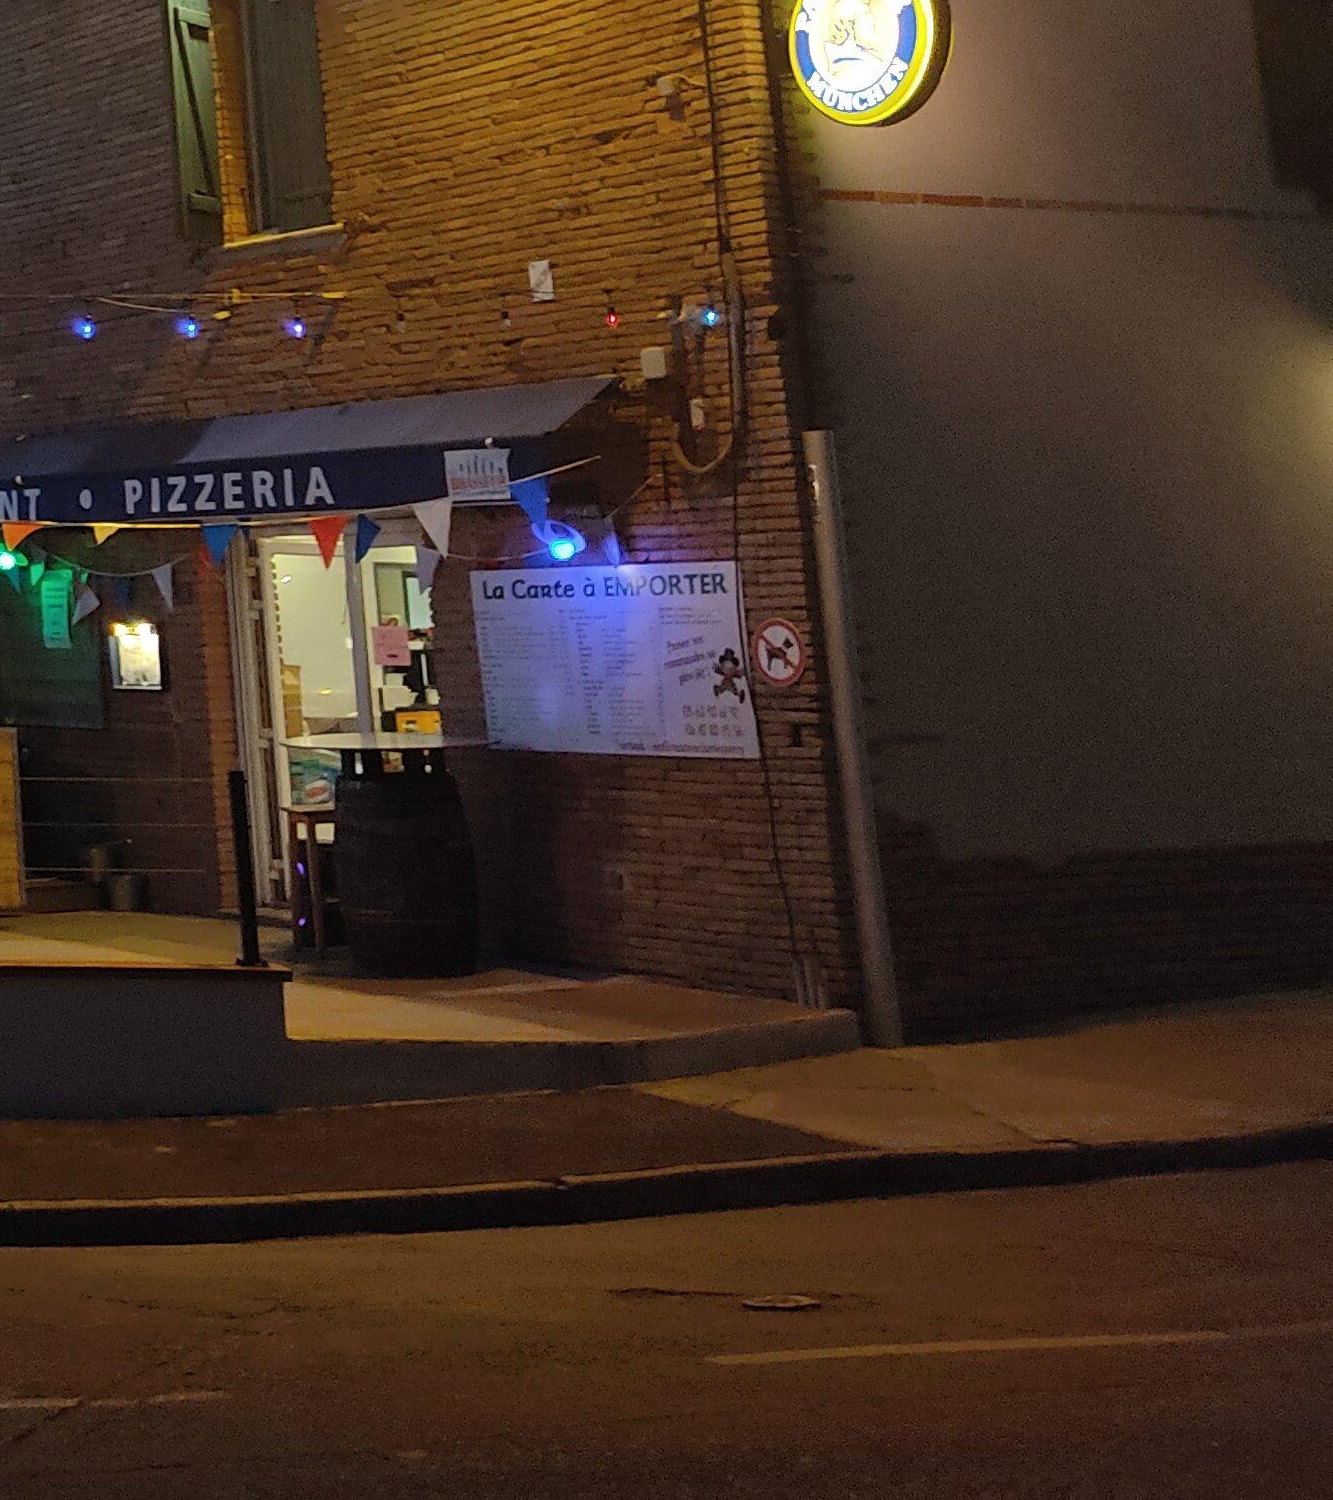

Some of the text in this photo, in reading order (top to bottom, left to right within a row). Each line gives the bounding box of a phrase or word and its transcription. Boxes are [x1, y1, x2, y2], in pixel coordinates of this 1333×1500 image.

[123, 466, 335, 515] PIZZERIA
[482, 580, 505, 600] La
[583, 577, 597, 598] à
[603, 573, 728, 597] EMPORTER
